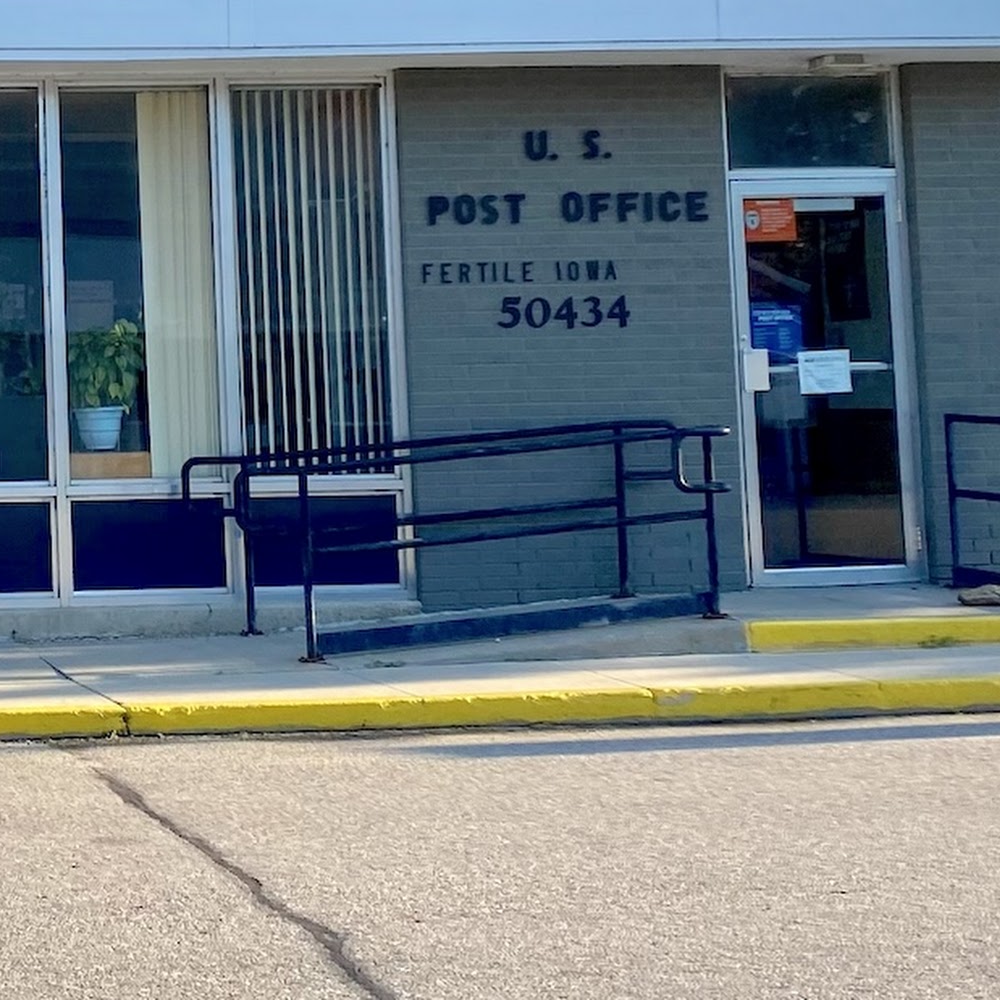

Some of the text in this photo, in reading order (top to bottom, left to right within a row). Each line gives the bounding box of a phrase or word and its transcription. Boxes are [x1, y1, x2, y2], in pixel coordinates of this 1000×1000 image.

[523, 129, 613, 161] U. S.
[426, 190, 709, 226] POST OFFICE
[422, 260, 618, 284] FERTILE IOWA
[497, 295, 631, 329] 50434
